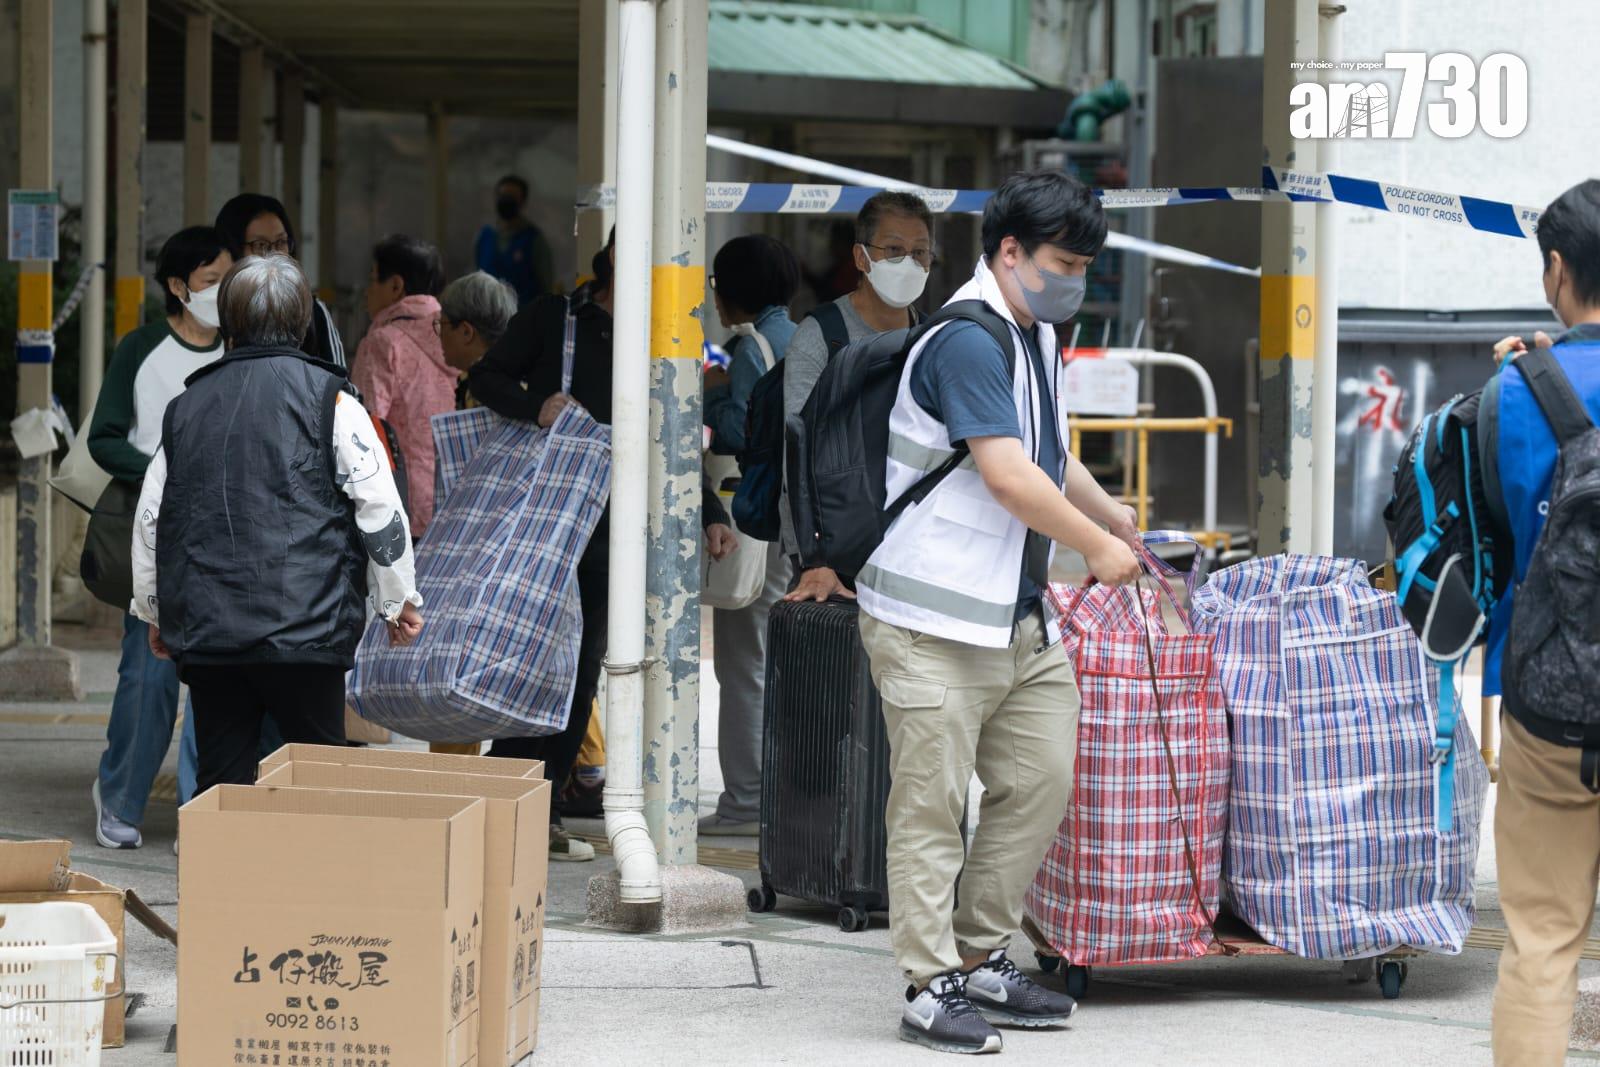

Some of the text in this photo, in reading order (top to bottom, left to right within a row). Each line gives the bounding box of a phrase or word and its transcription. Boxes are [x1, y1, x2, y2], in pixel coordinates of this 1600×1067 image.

[1385, 186, 1416, 200] POLICE
[1397, 203, 1463, 223] DO NOT CROSS
[310, 934, 392, 947] JIMMY MOVING
[265, 1012, 359, 1031] 9092 8613
